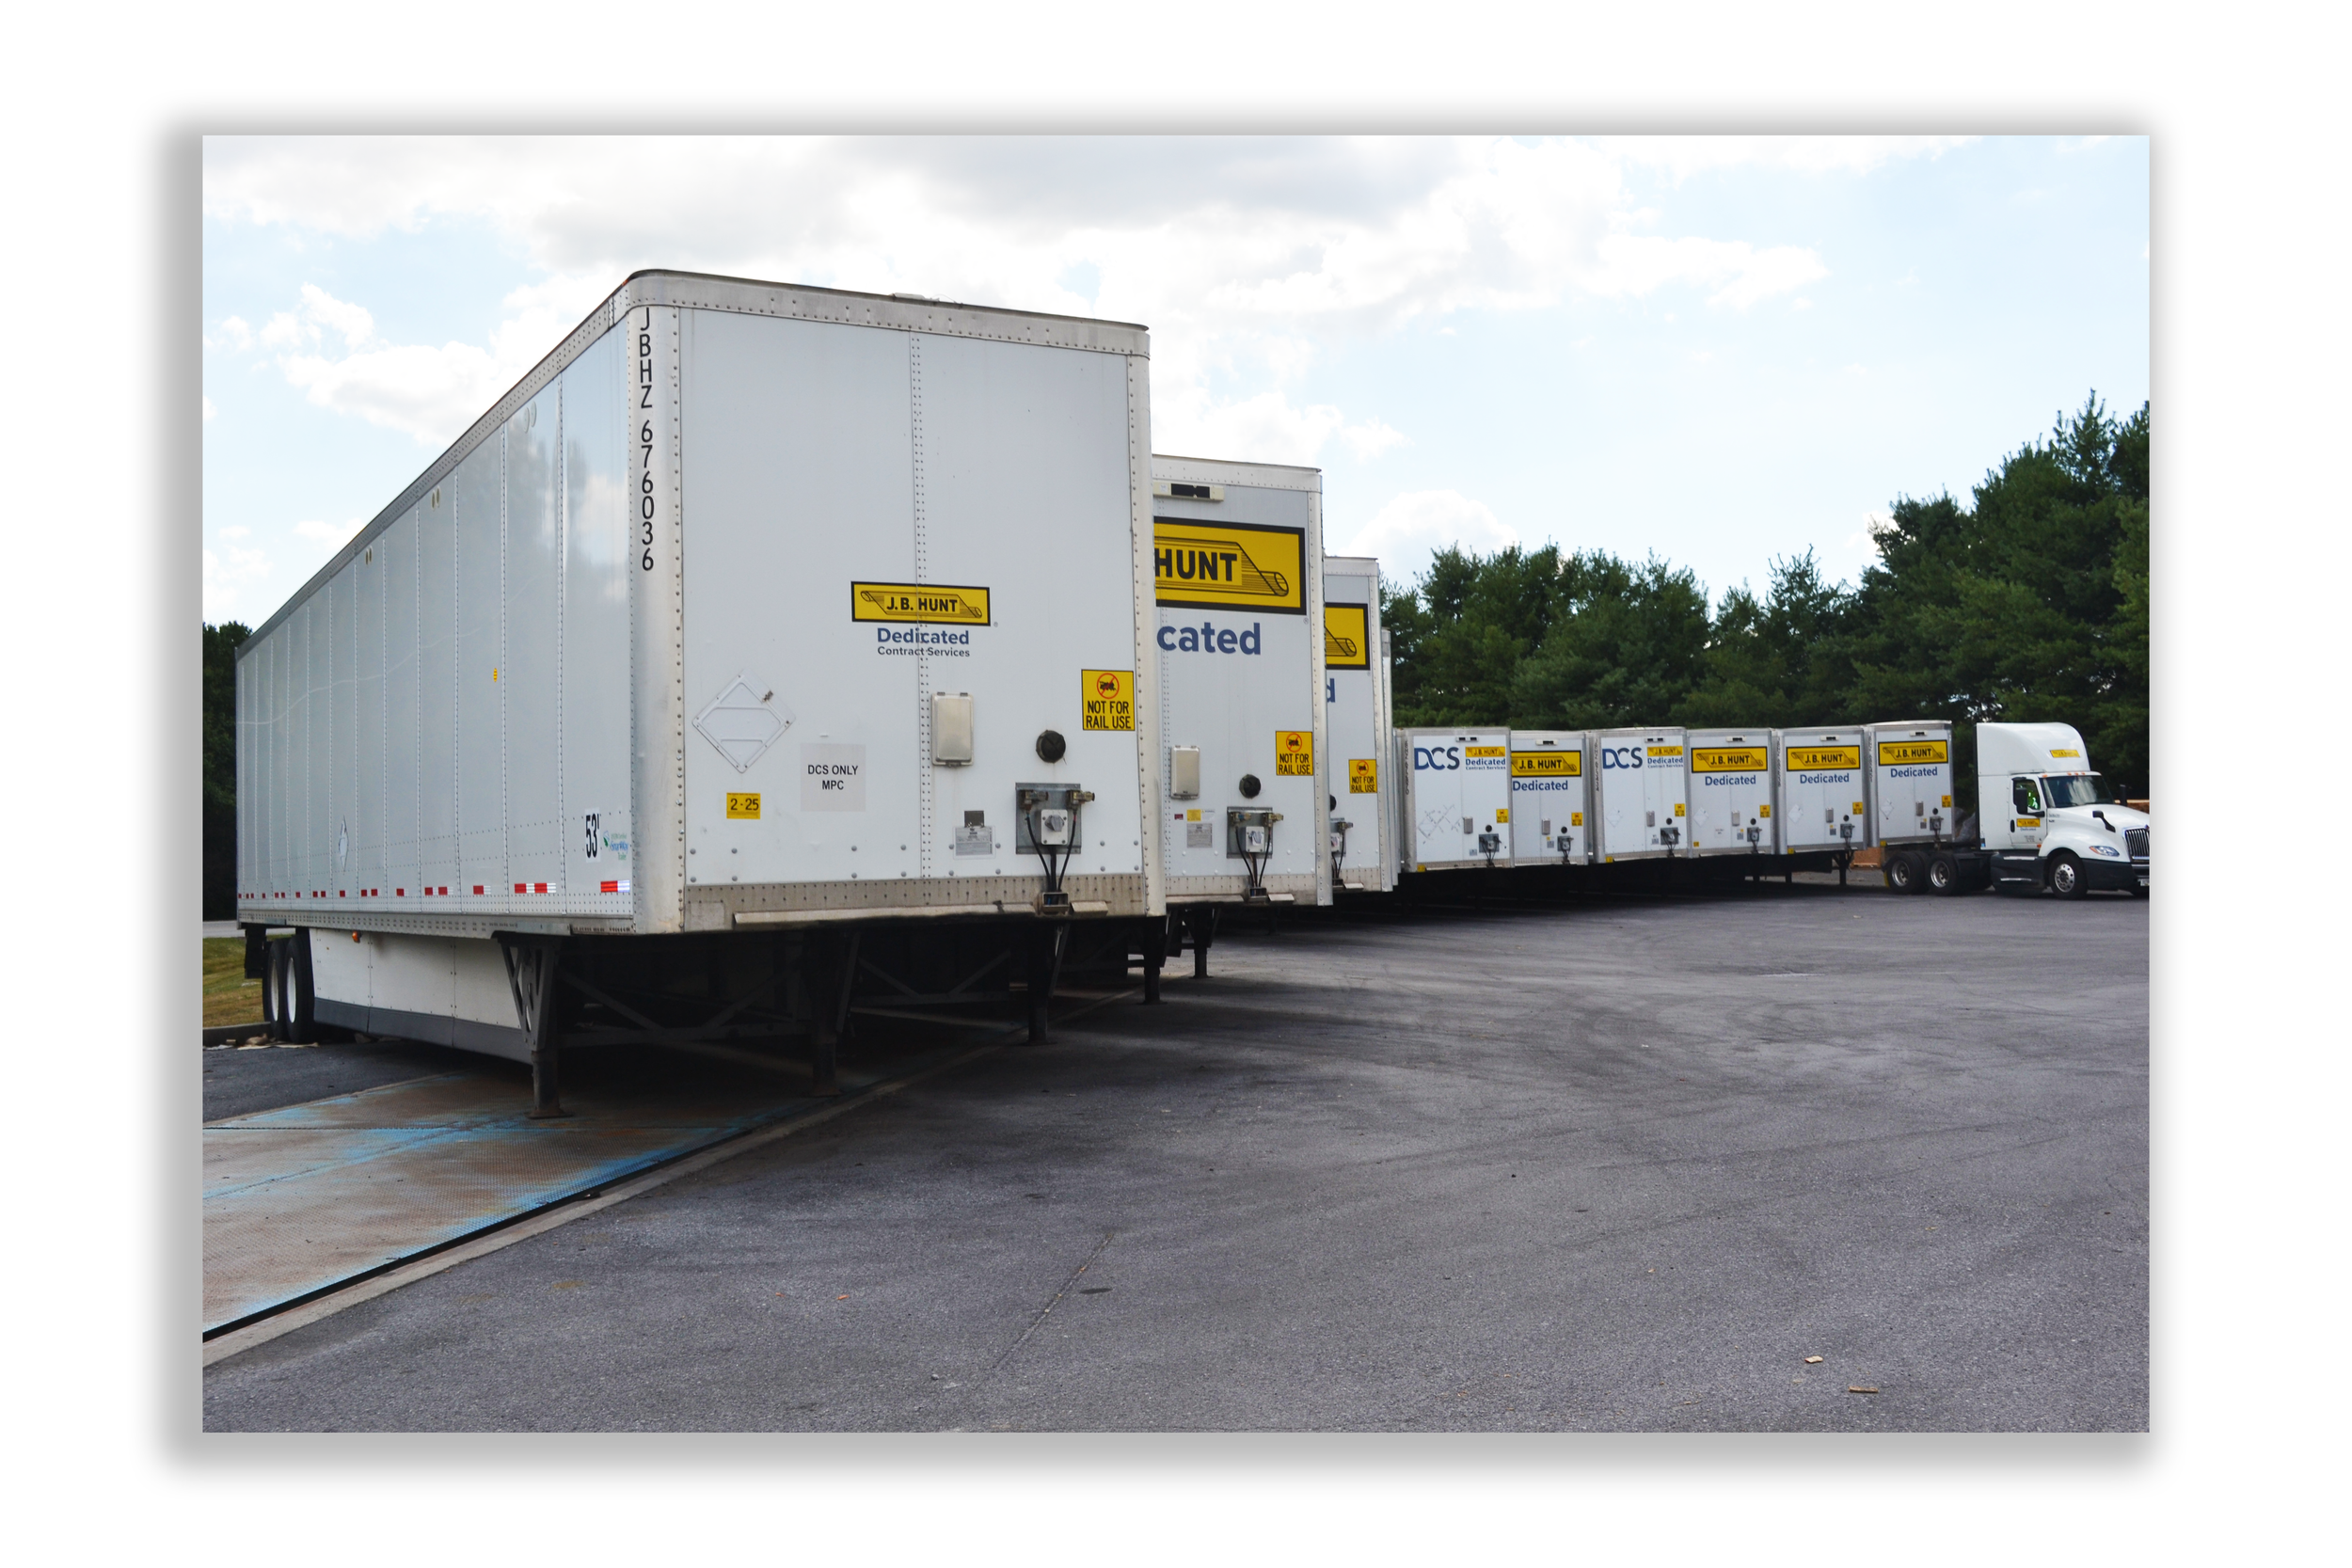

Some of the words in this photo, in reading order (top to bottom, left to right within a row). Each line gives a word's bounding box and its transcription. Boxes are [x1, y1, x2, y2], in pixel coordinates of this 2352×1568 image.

[639, 307, 654, 409] JBHZ
[640, 420, 655, 572] 676036
[1154, 547, 1238, 582] HUNT
[918, 597, 958, 612] HUNT
[877, 627, 970, 645] Dedicated
[1156, 621, 1262, 656] cated
[877, 646, 925, 657] Contract
[927, 646, 970, 657] Services
[1087, 700, 1106, 714] NOT
[1109, 700, 1130, 715] FOR
[1086, 715, 1109, 729] RAIL
[1112, 715, 1132, 729] USE
[1414, 746, 1460, 770] DCS
[1602, 747, 1643, 769] DCS
[1821, 753, 1843, 763] HUNT
[1911, 748, 1931, 757] HUNT
[1279, 753, 1294, 764] NOT
[1295, 753, 1310, 764] FOR
[1465, 757, 1506, 766] Dedicated
[1537, 759, 1562, 769] HUNT
[1647, 756, 1683, 765] Dedicated
[1727, 755, 1750, 765] HUNT
[807, 764, 829, 775] DCS
[832, 765, 859, 776] ONLY
[1278, 765, 1295, 775] RAIL
[1296, 765, 1311, 775] USE
[1890, 766, 1938, 778] Dedicated
[1705, 774, 1756, 786] Dedicated
[1800, 773, 1850, 784] Dedicated
[821, 780, 845, 790] MPC
[1364, 784, 1375, 793] USE
[1512, 780, 1568, 791] Dedicated
